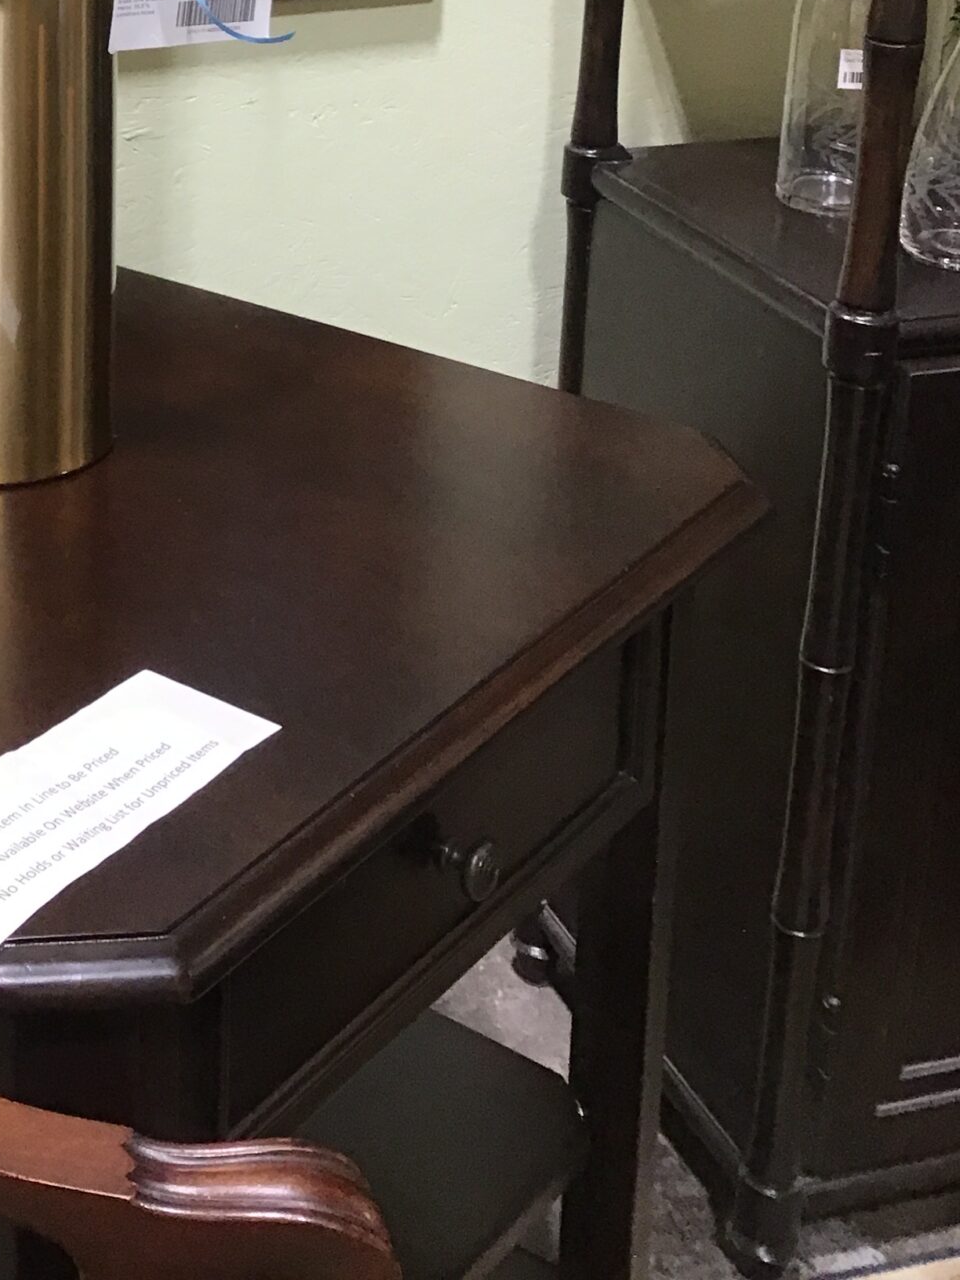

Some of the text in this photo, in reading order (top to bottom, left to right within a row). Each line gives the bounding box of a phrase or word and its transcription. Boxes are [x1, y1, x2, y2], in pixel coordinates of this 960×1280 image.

[14, 860, 53, 885] Holds
[51, 850, 67, 862] or
[61, 822, 113, 851] Waiting
[104, 809, 131, 824] List
[123, 796, 145, 811] for
[141, 761, 192, 798] Unpriced
[186, 740, 220, 762] Items
[18, 802, 36, 813] In
[30, 787, 59, 804] Line
[55, 781, 72, 791] to
[67, 771, 88, 782] Be
[83, 746, 120, 772] Priced
[43, 817, 65, 830] On
[59, 790, 109, 818] Website
[103, 766, 140, 791] When
[134, 742, 171, 768] Priced
